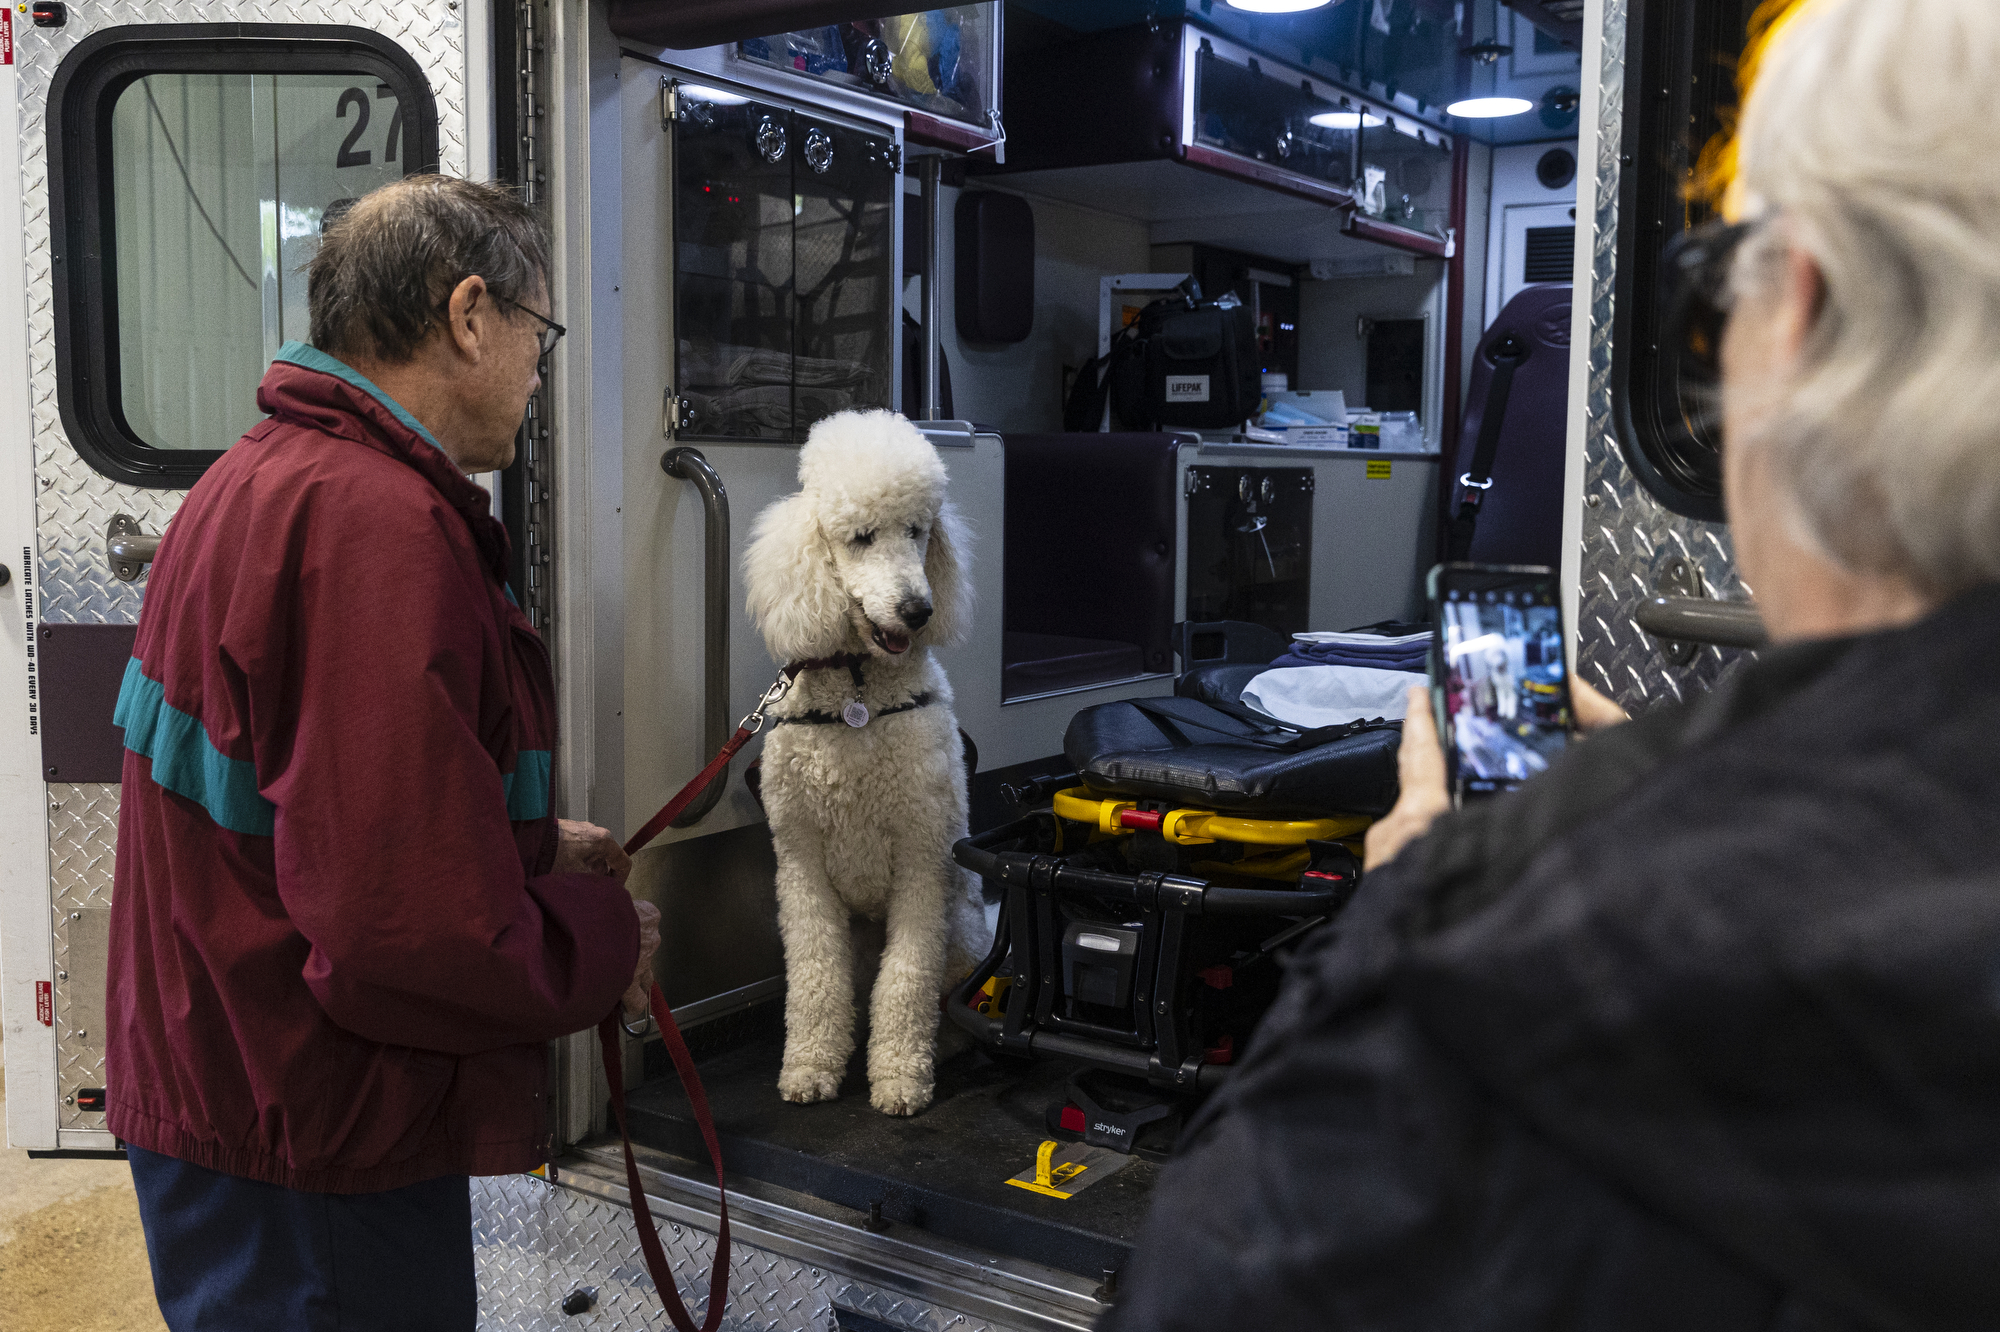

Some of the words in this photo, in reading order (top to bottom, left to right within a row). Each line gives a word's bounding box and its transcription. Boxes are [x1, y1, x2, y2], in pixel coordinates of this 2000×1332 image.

[336, 83, 402, 168] 27
[1171, 382, 1202, 392] LIFEPAK
[23, 546, 32, 585] LUBRICATE
[25, 589, 33, 618] LATCHES
[26, 622, 34, 641] WITH
[27, 645, 35, 672] WD-40
[28, 676, 36, 699] EVERY
[29, 703, 37, 712] 30
[30, 716, 38, 735] DAYS
[1093, 1122, 1126, 1136] stryker
